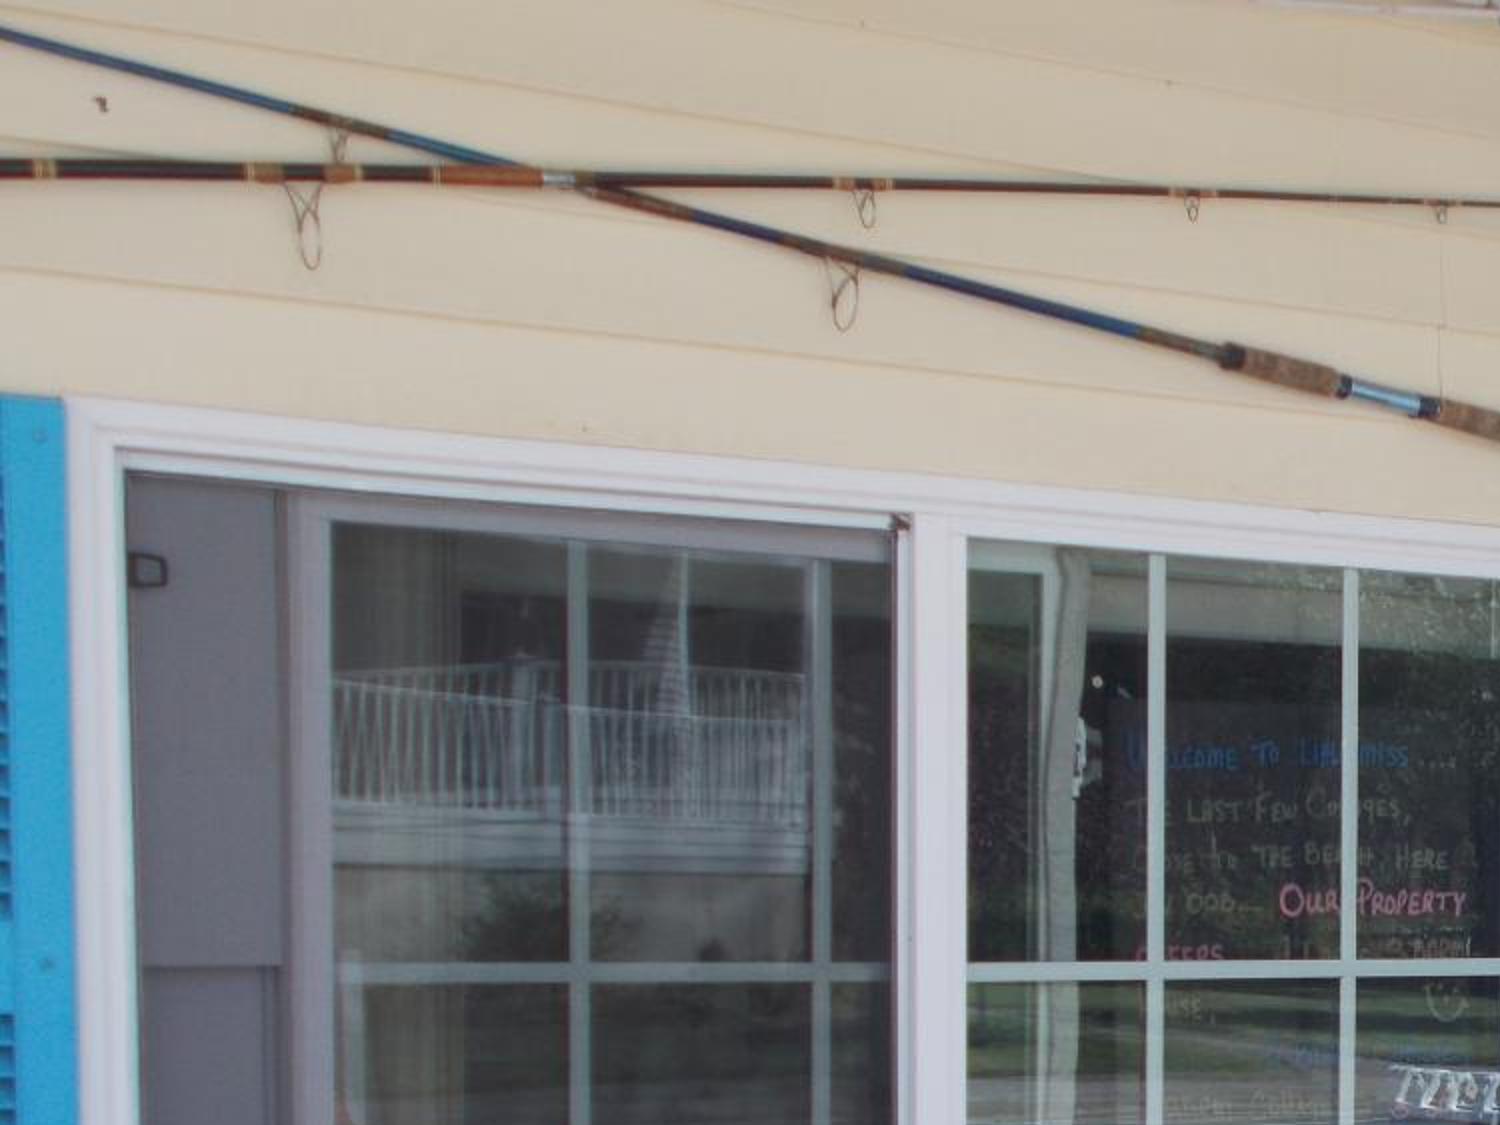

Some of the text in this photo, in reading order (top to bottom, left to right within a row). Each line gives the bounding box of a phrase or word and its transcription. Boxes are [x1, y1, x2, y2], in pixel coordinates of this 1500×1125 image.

[1187, 798, 1243, 824] LAST
[1254, 790, 1299, 824] FEW
[1394, 843, 1449, 871] HERE
[1280, 881, 1341, 918] OUR
[1359, 877, 1468, 917] PROPERTY
